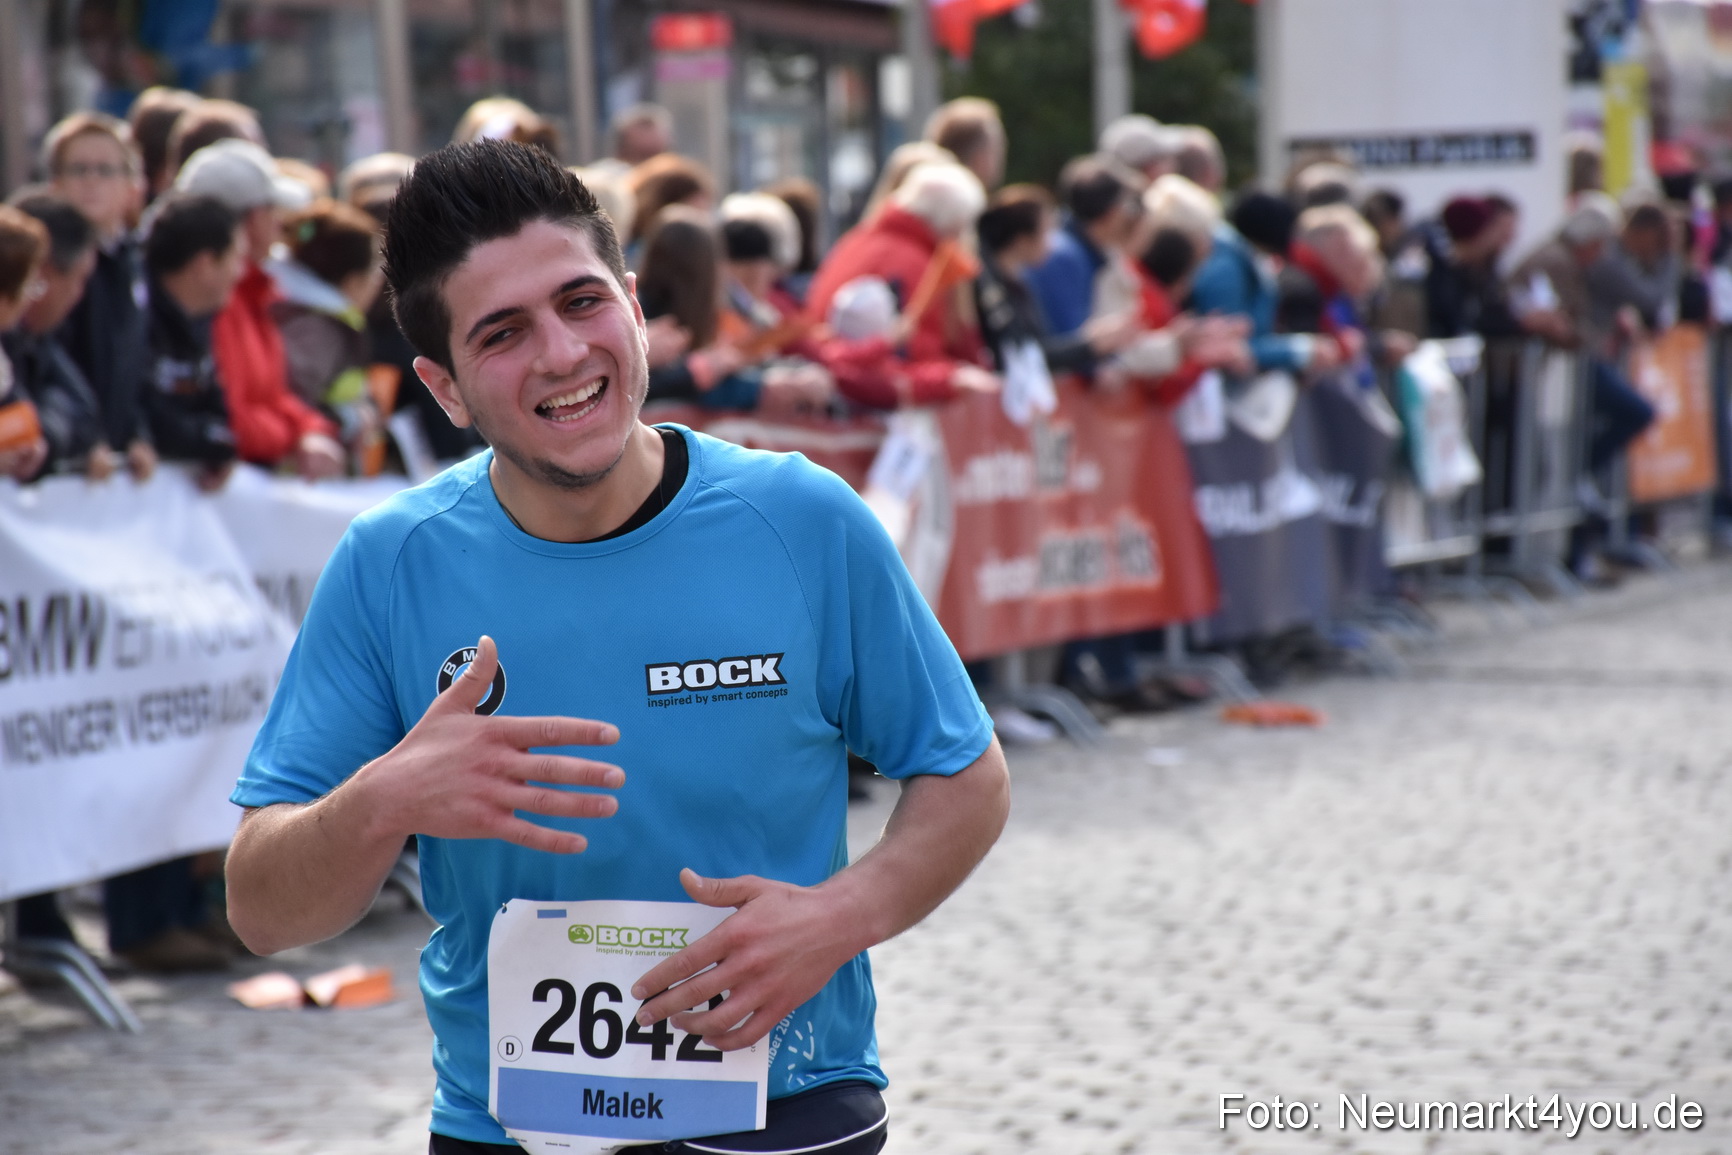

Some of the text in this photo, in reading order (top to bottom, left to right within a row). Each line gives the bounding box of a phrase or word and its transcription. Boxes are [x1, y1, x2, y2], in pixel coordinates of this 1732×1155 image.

[443, 649, 478, 677] BM
[646, 654, 785, 694] BOCK
[647, 687, 788, 708] inspired by smart concepts
[596, 925, 689, 949] BOCK
[596, 946, 624, 955] inspired
[625, 949, 634, 957] by
[531, 978, 724, 1063] 2642
[505, 1042, 515, 1056] D
[581, 1087, 665, 1121] Malek
